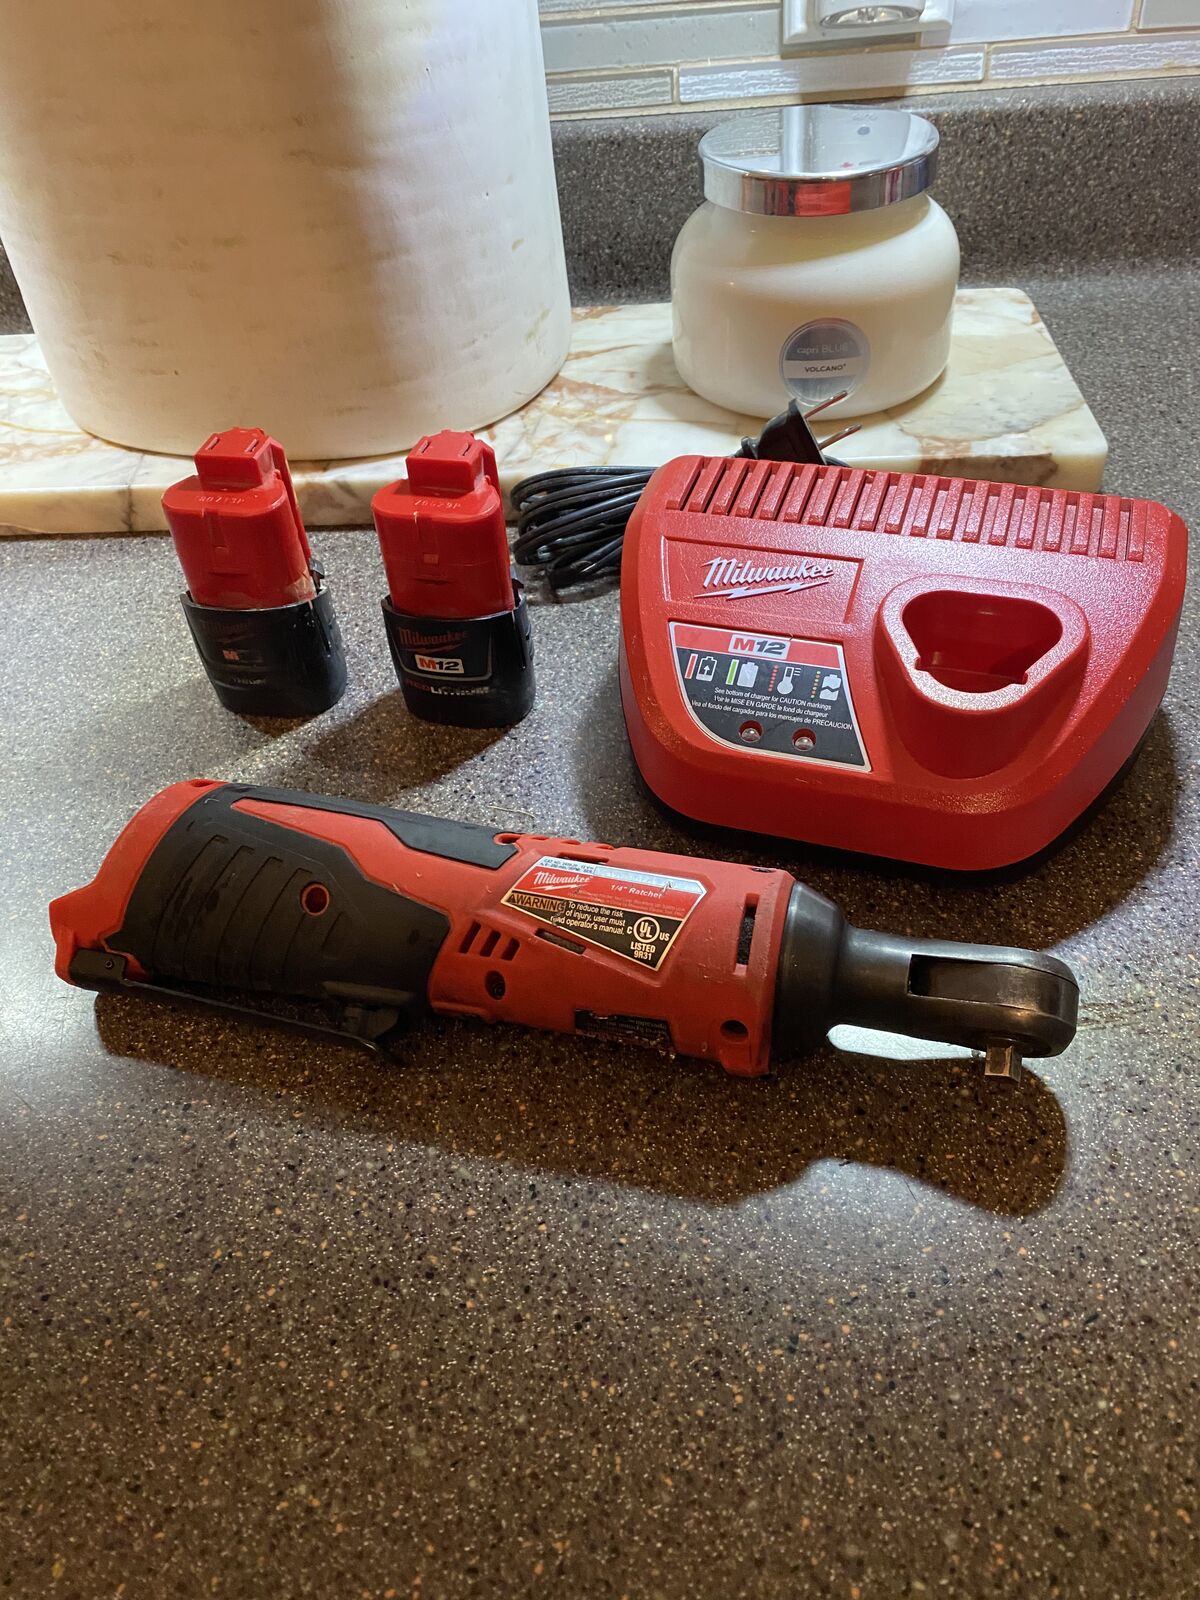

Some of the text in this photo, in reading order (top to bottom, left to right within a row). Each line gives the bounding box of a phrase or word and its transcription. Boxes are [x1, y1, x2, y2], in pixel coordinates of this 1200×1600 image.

[797, 342, 849, 355] capri BLUE
[804, 364, 844, 374] VOLCANO
[701, 556, 834, 588] Milwaukee
[731, 637, 786, 655] M12
[418, 657, 460, 671] M12
[715, 686, 725, 694] See
[725, 689, 743, 697] bottom
[750, 693, 771, 702] charger
[779, 697, 806, 707] CAUTION
[807, 701, 832, 710] markings
[730, 697, 745, 706] MISE
[746, 699, 754, 707] EN
[755, 701, 776, 711] GARDE
[804, 709, 829, 718] chargeur
[708, 702, 722, 710] fondo
[732, 706, 755, 715] cargador
[755, 710, 768, 718] para
[777, 714, 803, 723] mensajes
[812, 718, 852, 730] PRECAUCION
[533, 870, 591, 885] Milwaukee
[628, 887, 662, 899] Ratchet
[516, 894, 565, 913] WARNING
[576, 903, 599, 913] reduce
[600, 907, 610, 915] the
[566, 918, 598, 930] operator's
[599, 924, 625, 935] manual.
[593, 915, 608, 923] user
[608, 918, 626, 926] must
[640, 921, 653, 938] UL
[659, 932, 670, 941] US
[630, 941, 656, 953] LISTED
[633, 950, 652, 961] 9R31
